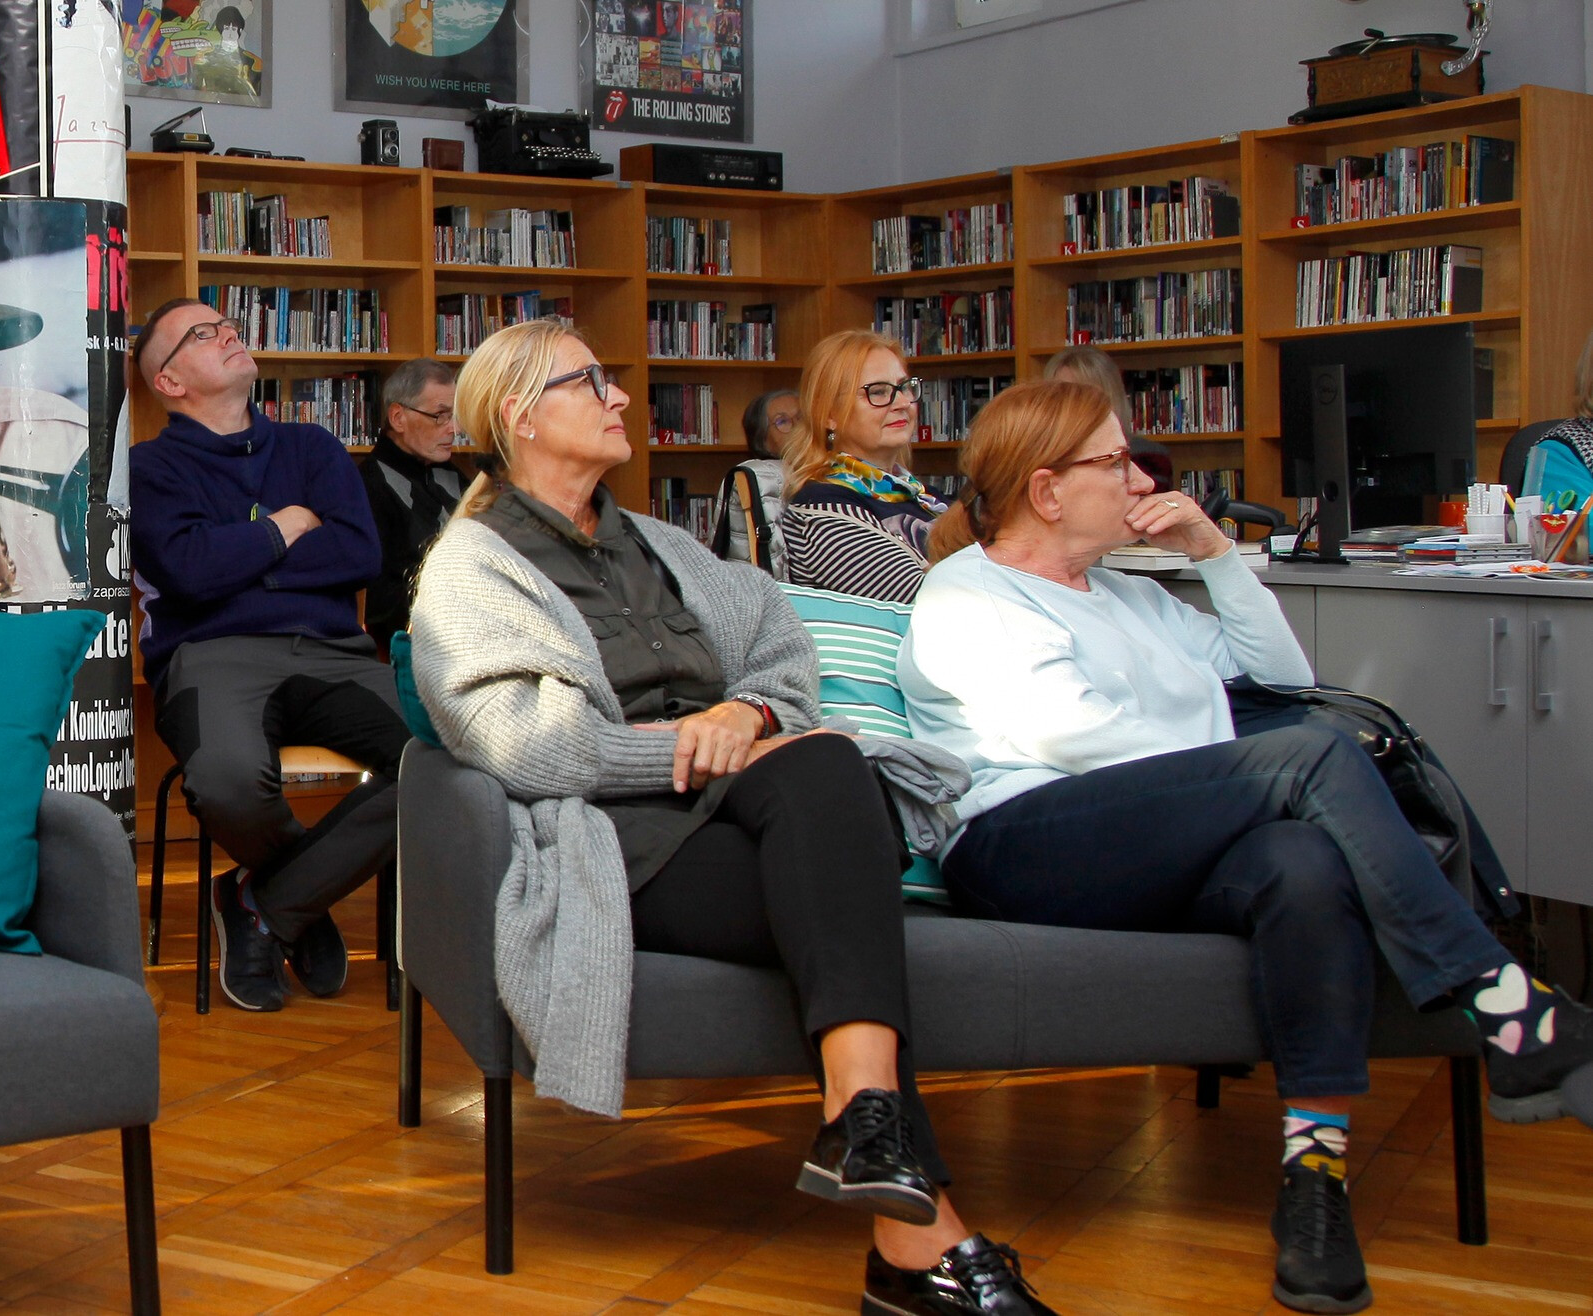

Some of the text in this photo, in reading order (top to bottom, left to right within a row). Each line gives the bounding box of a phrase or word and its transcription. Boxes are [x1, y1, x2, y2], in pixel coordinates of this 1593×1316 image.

[375, 74, 491, 93] WISH YOU WERE HERE
[631, 97, 731, 125] THE ROLLING STONES
[1063, 245, 1073, 256] K
[1077, 333, 1087, 346] L
[921, 428, 930, 440] F
[69, 697, 130, 742] Konikiewicz
[46, 748, 125, 801] echnoLogical
